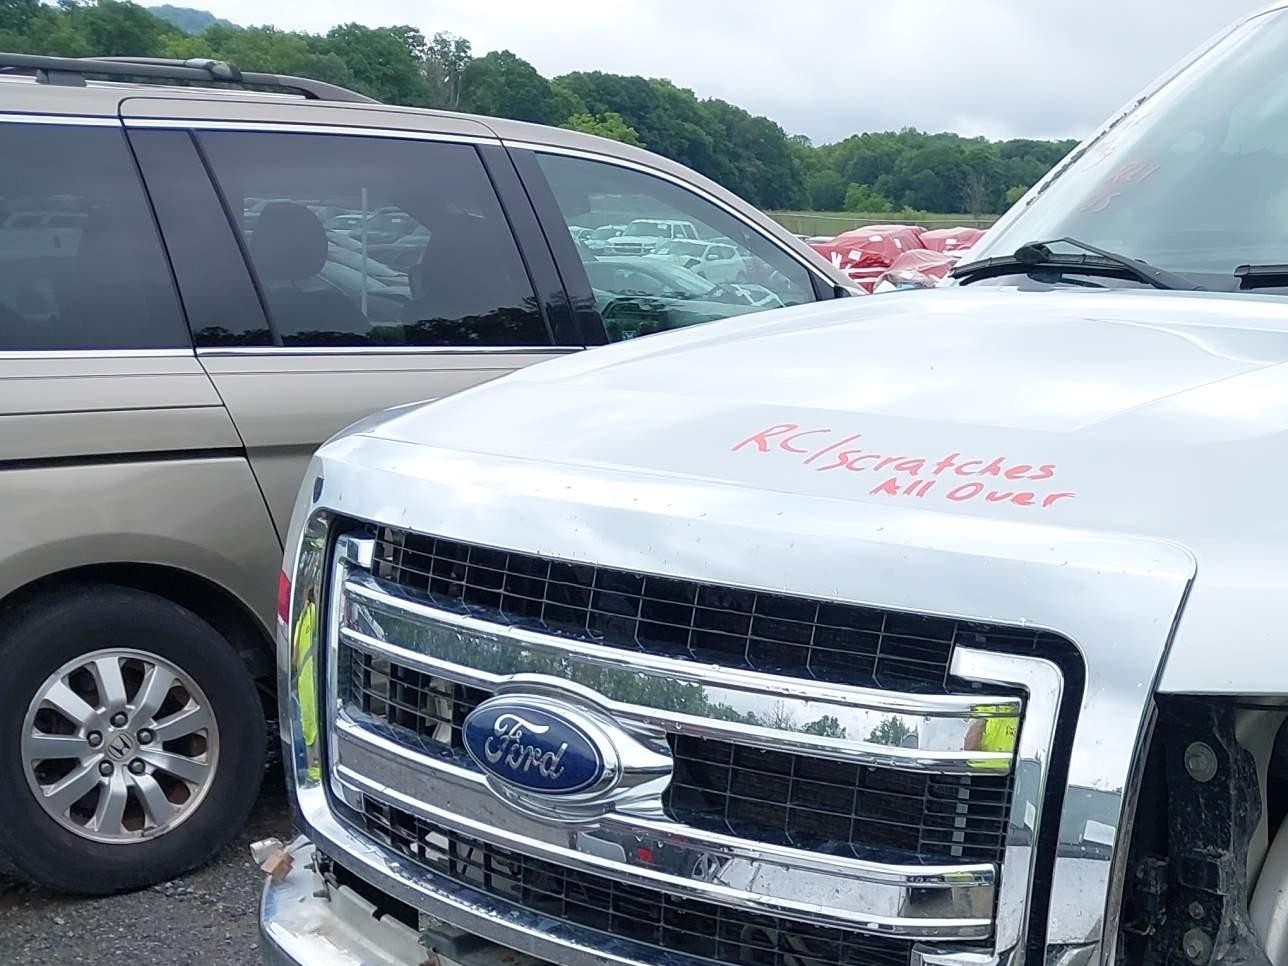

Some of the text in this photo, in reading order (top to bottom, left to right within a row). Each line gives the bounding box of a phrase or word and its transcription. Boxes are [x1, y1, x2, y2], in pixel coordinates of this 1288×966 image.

[869, 477, 1077, 507] All Over
[484, 713, 570, 780] Ford
